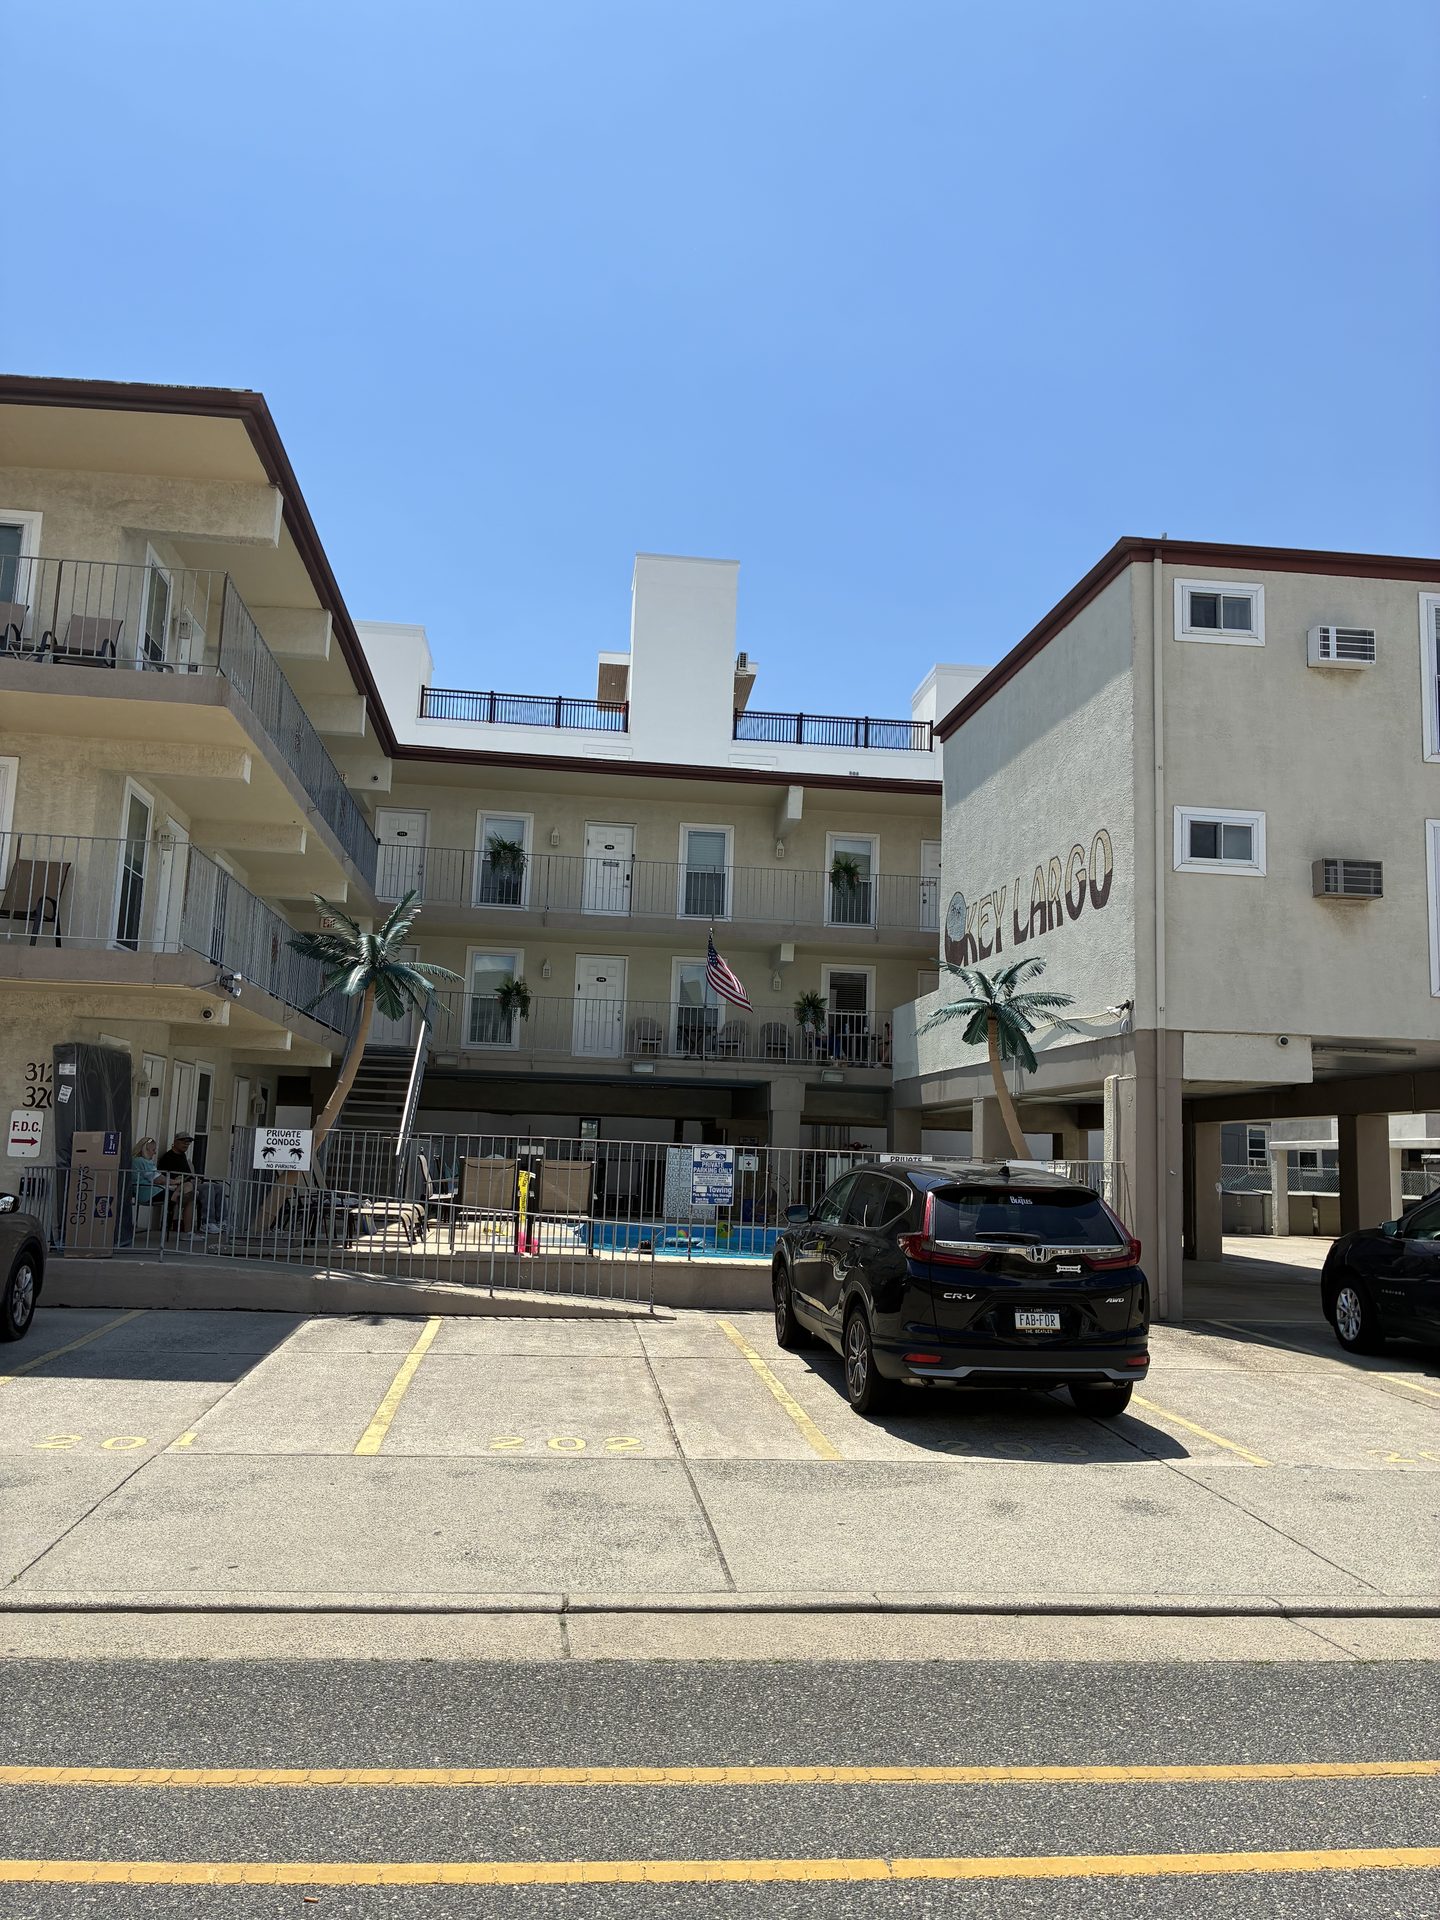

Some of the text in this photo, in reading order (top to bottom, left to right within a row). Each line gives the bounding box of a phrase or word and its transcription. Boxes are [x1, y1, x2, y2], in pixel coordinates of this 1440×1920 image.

[962, 828, 1114, 967] KEY LARGO
[12, 1121, 41, 1133] F.D.C.
[266, 1130, 302, 1139] PRIVATE
[266, 1138, 301, 1146] CONDOS
[709, 1186, 732, 1195] Towing
[943, 1292, 976, 1301] CR-V
[32, 1432, 199, 1449] 201
[488, 1434, 645, 1451] 202
